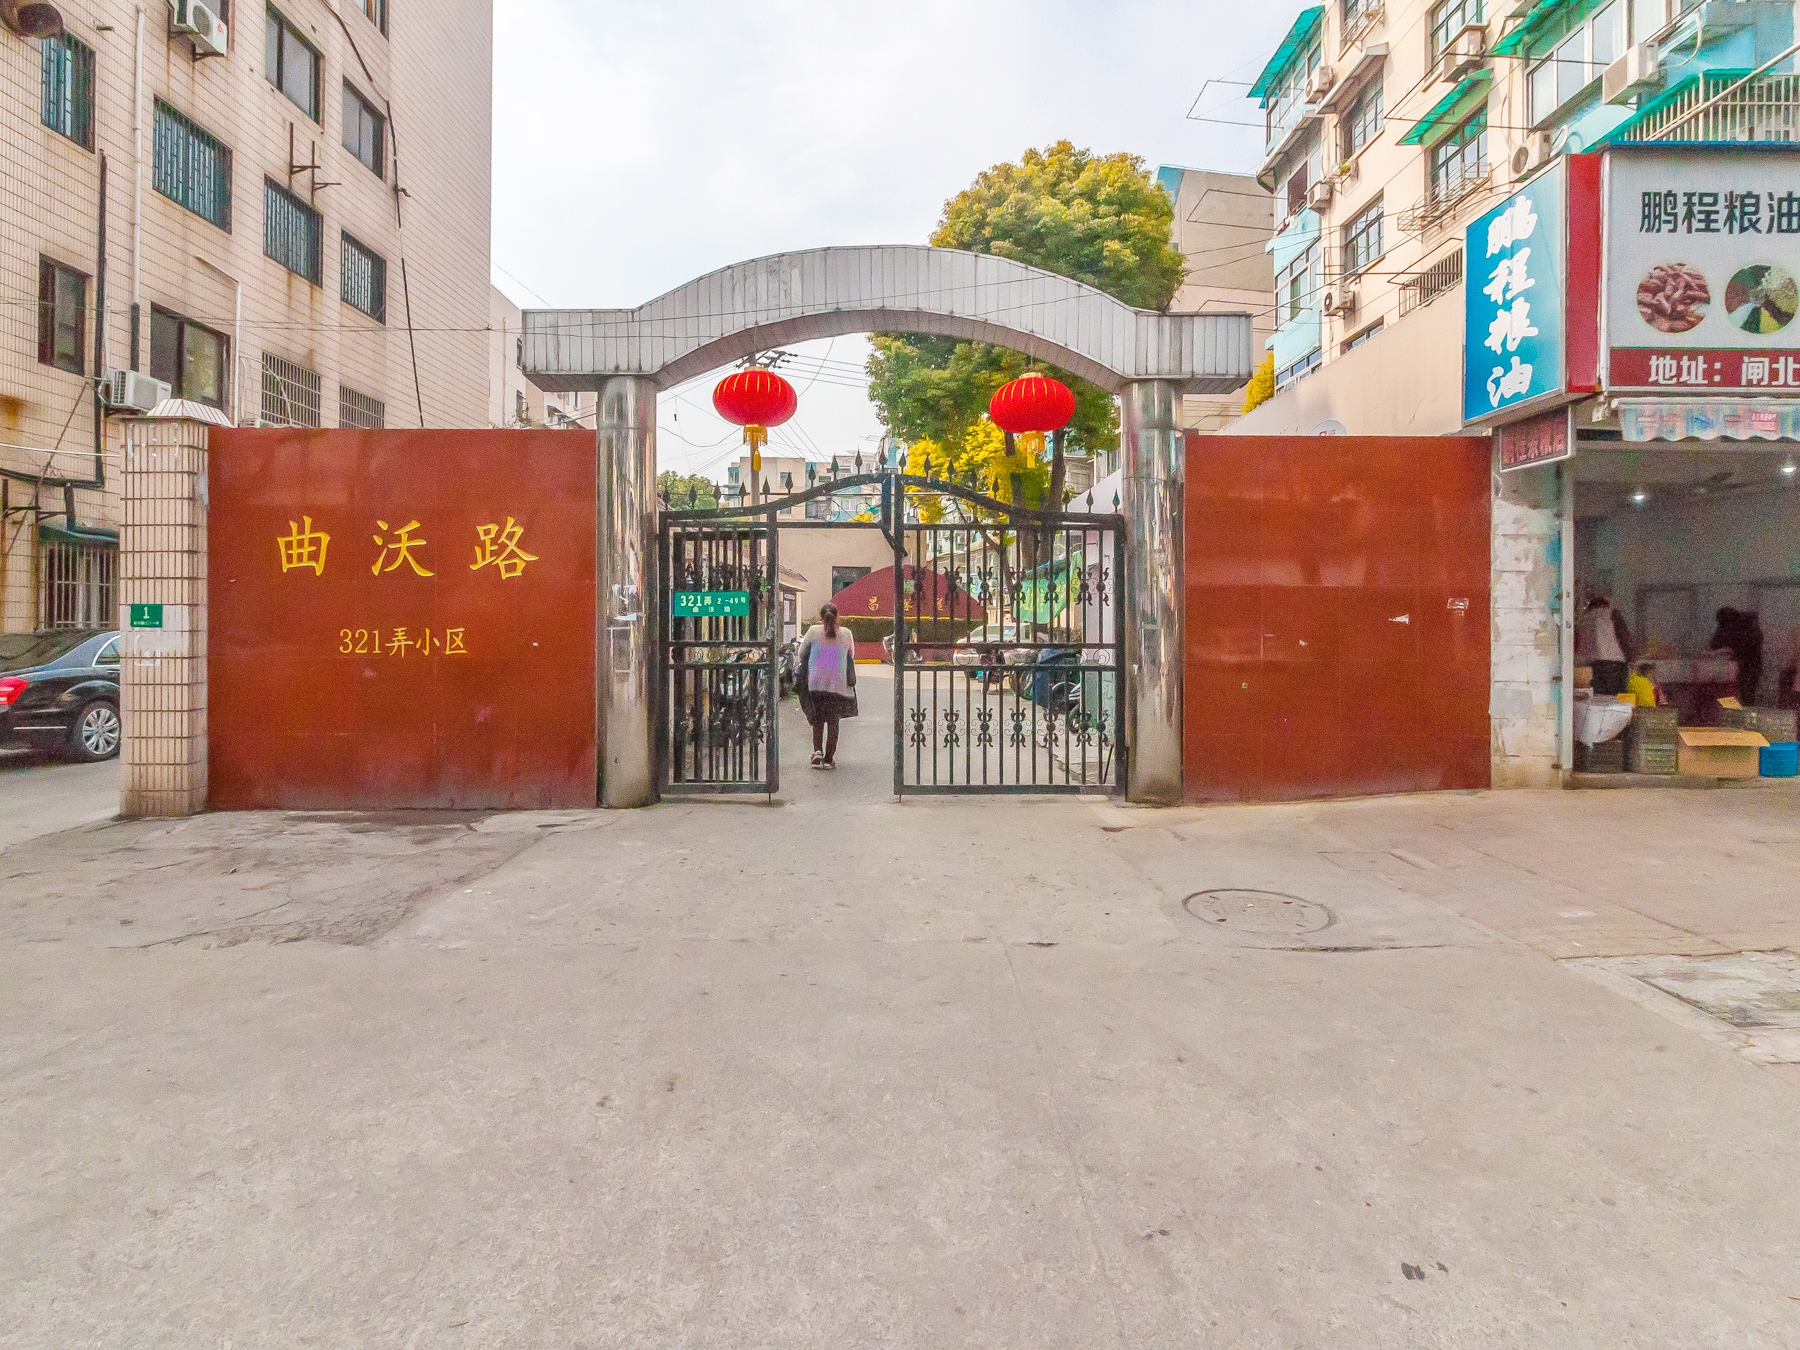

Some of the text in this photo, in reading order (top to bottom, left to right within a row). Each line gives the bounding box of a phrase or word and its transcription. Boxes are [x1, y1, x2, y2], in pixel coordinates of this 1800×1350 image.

[1639, 190, 1800, 234] 鹏程粮油
[1483, 195, 1539, 408] 鹏程粮油
[277, 515, 539, 579] 曲沃路
[339, 627, 468, 657] 321弄小区
